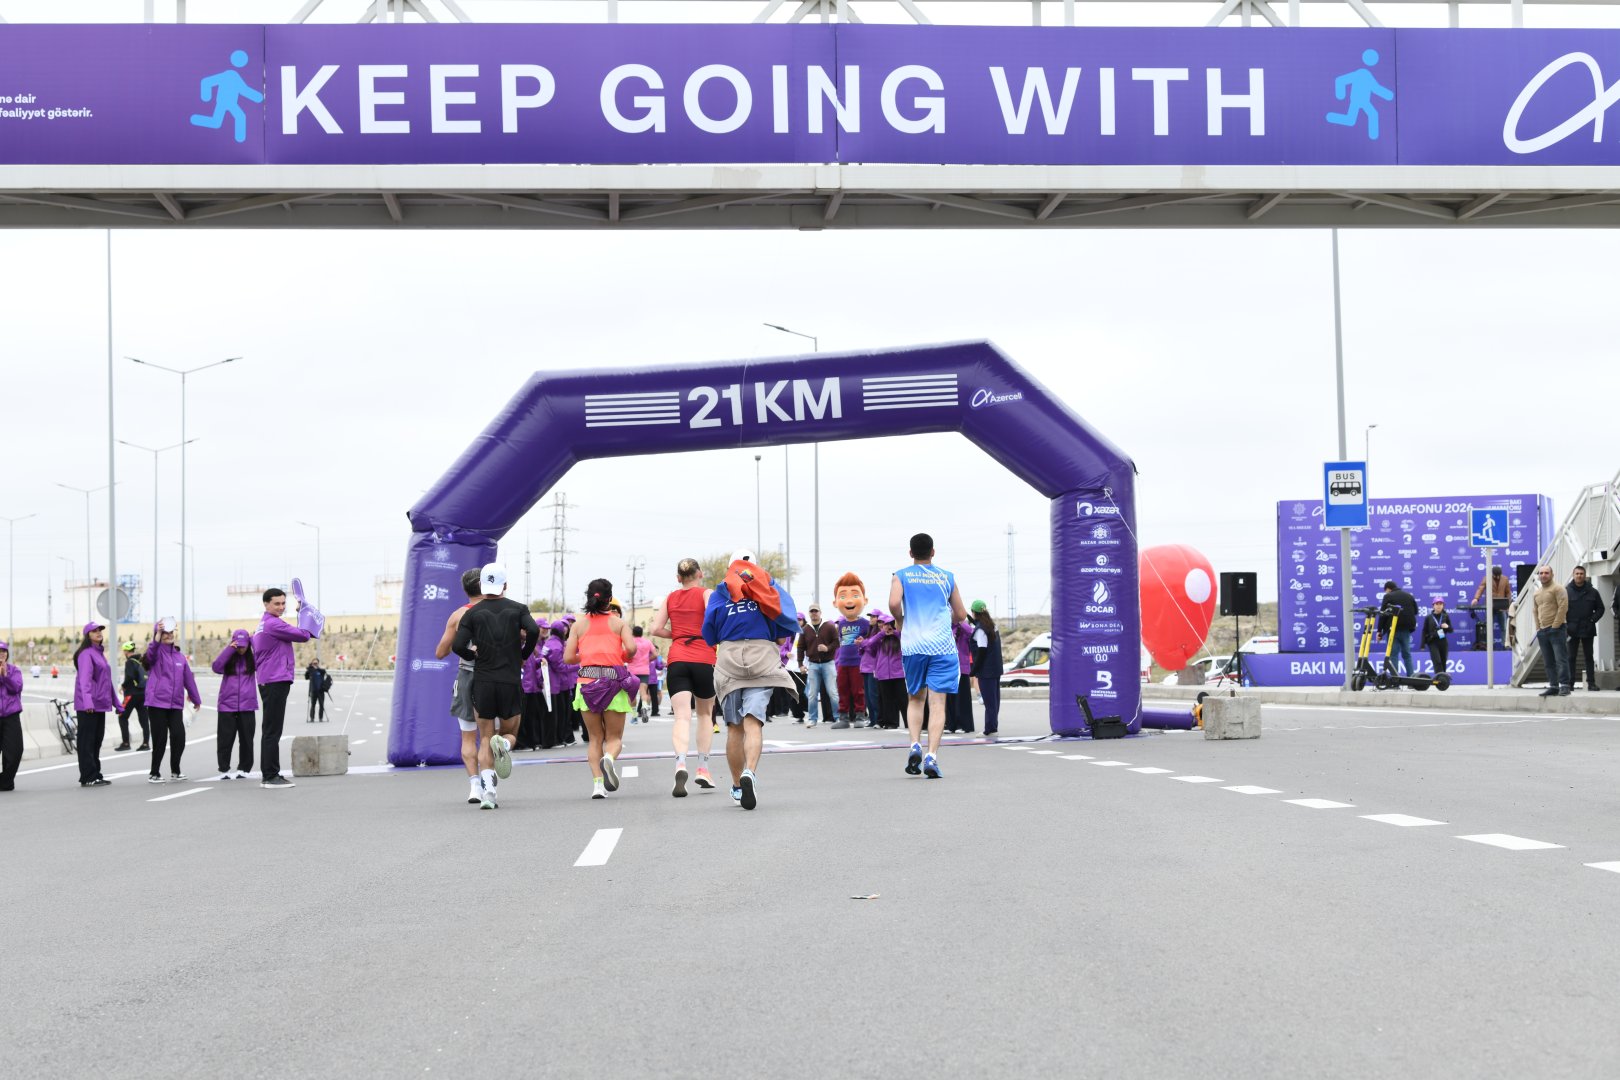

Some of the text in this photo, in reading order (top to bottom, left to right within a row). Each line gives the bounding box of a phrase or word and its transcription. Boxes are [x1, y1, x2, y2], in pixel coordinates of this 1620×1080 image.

[14, 93, 36, 104] dair
[281, 63, 1265, 136] KEEP GOING WITH
[47, 107, 93, 120] göstərir.
[687, 376, 843, 429] 21 KM
[990, 391, 1023, 403] Azercell
[1335, 472, 1355, 480] BUS
[1376, 503, 1442, 515] MARAFONU
[1085, 605, 1114, 614] SOCAR
[1083, 644, 1119, 655] XIRDALAN
[1290, 661, 1326, 675] BAKI
[1424, 659, 1466, 674] 226
